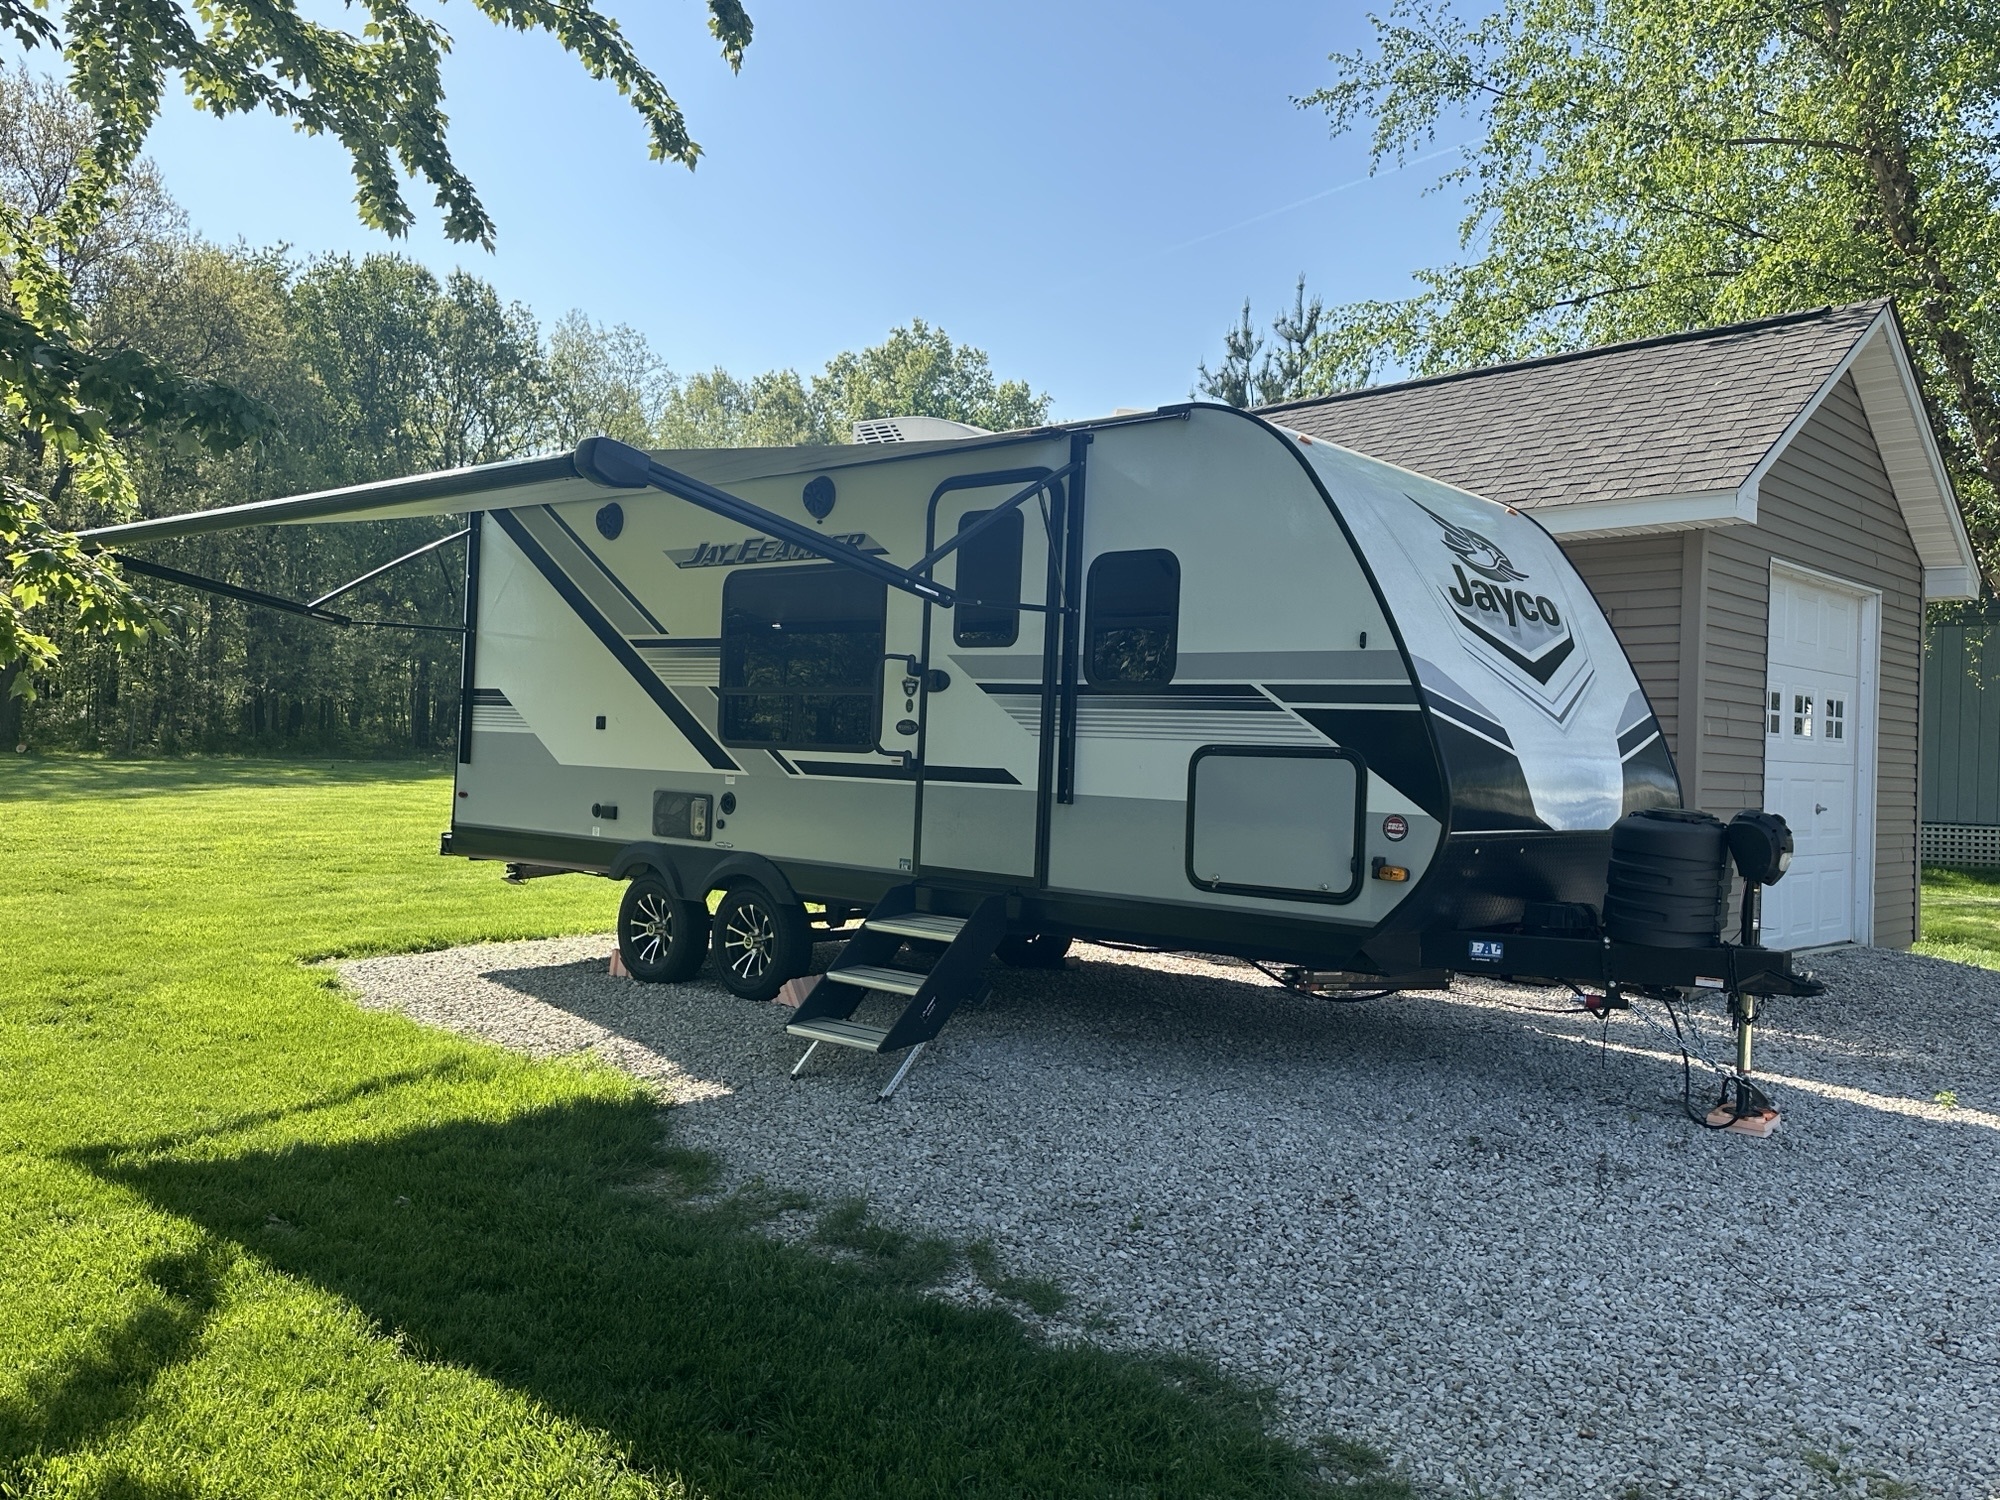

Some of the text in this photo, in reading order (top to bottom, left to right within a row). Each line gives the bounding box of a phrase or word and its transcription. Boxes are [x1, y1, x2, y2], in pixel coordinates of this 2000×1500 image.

[682, 533, 866, 567] JAY FEAR
[1448, 563, 1561, 628] Jayco
[1471, 942, 1502, 955] BAL
